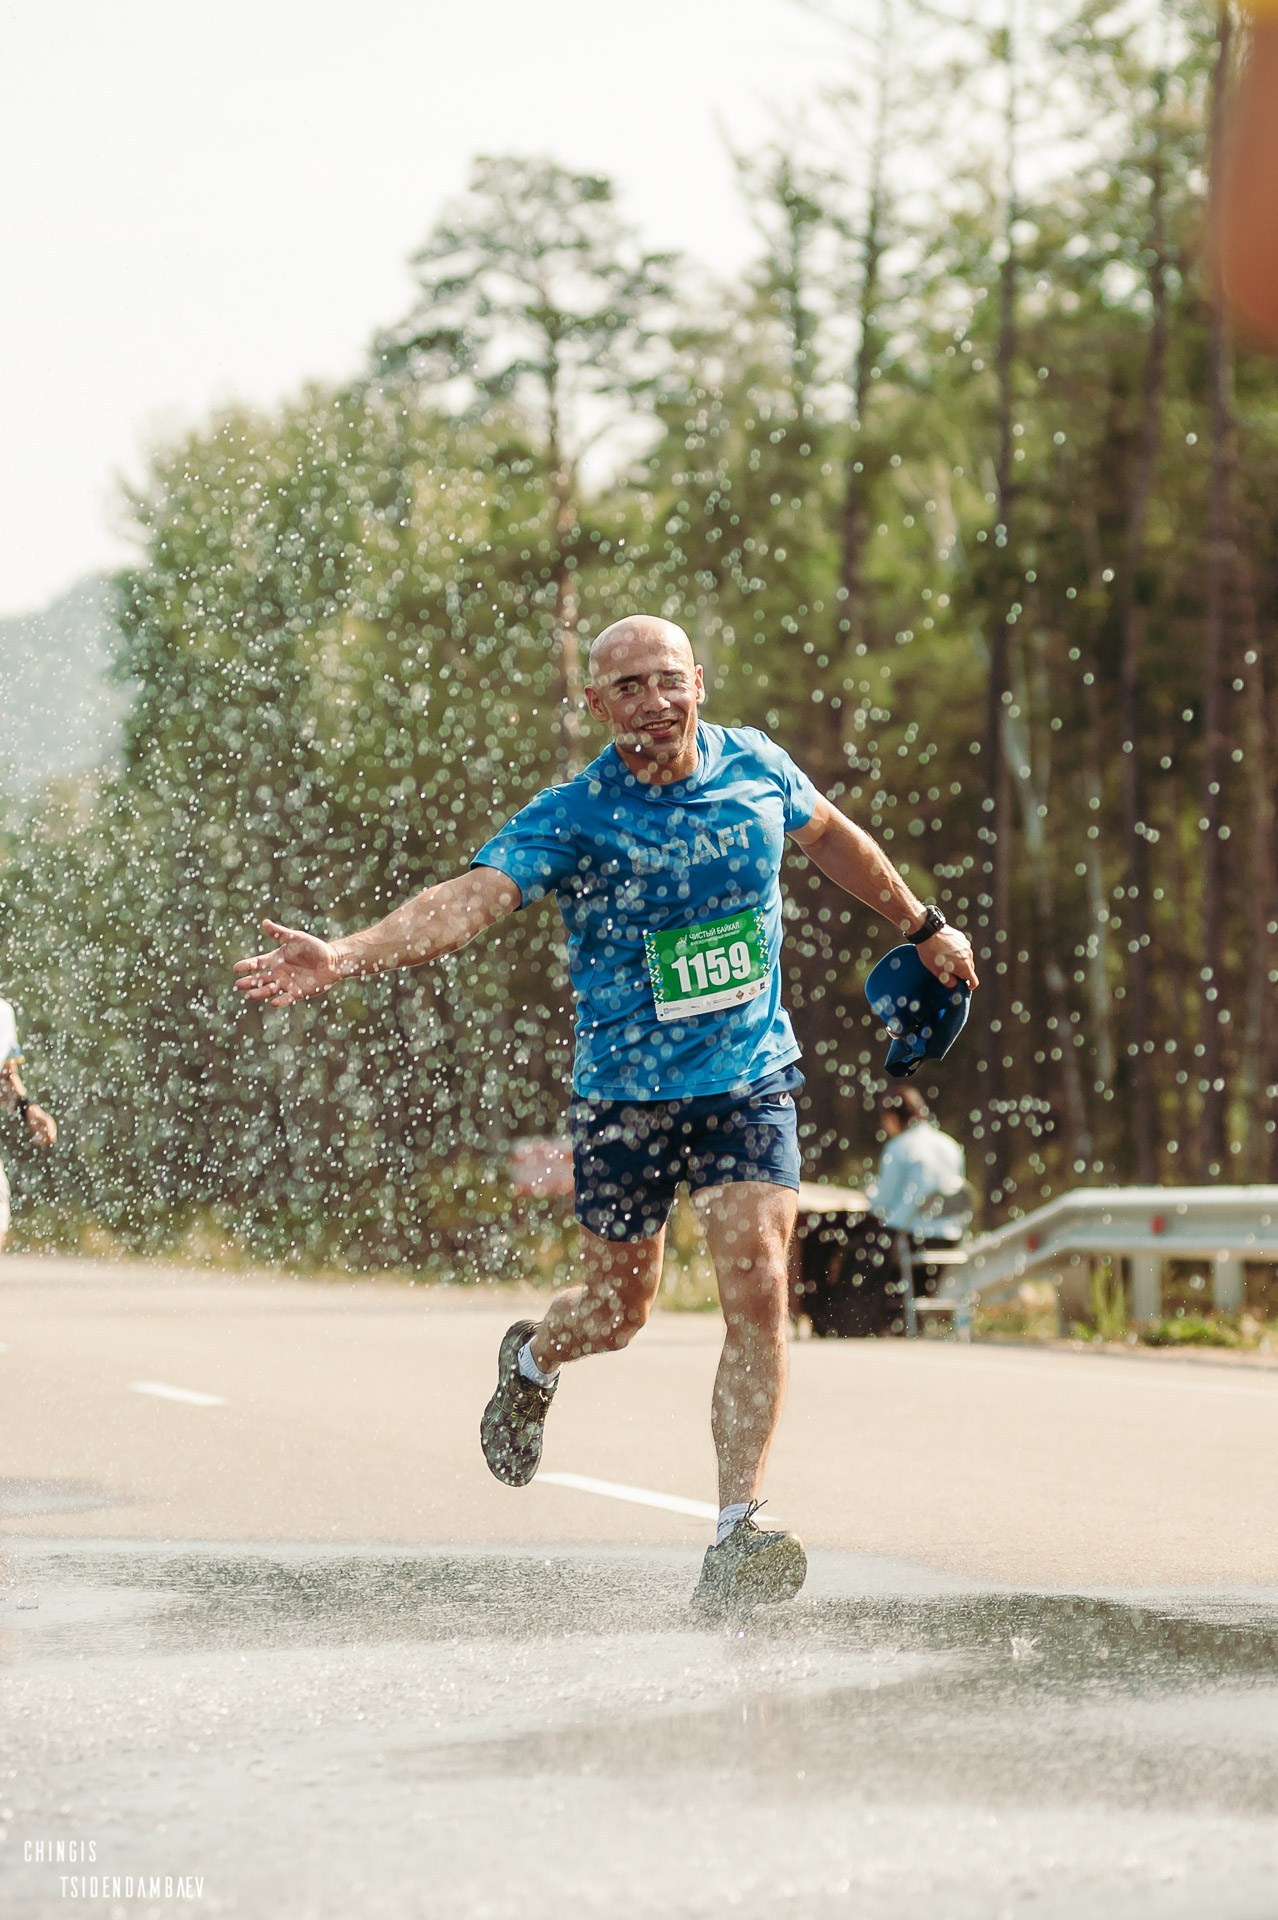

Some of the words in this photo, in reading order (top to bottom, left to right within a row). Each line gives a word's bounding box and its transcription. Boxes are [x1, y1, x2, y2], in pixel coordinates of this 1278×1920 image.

[689, 927, 716, 940] ЧИСТЫЙ
[716, 921, 740, 935] БАЙКАЛ
[671, 941, 751, 993] 1159
